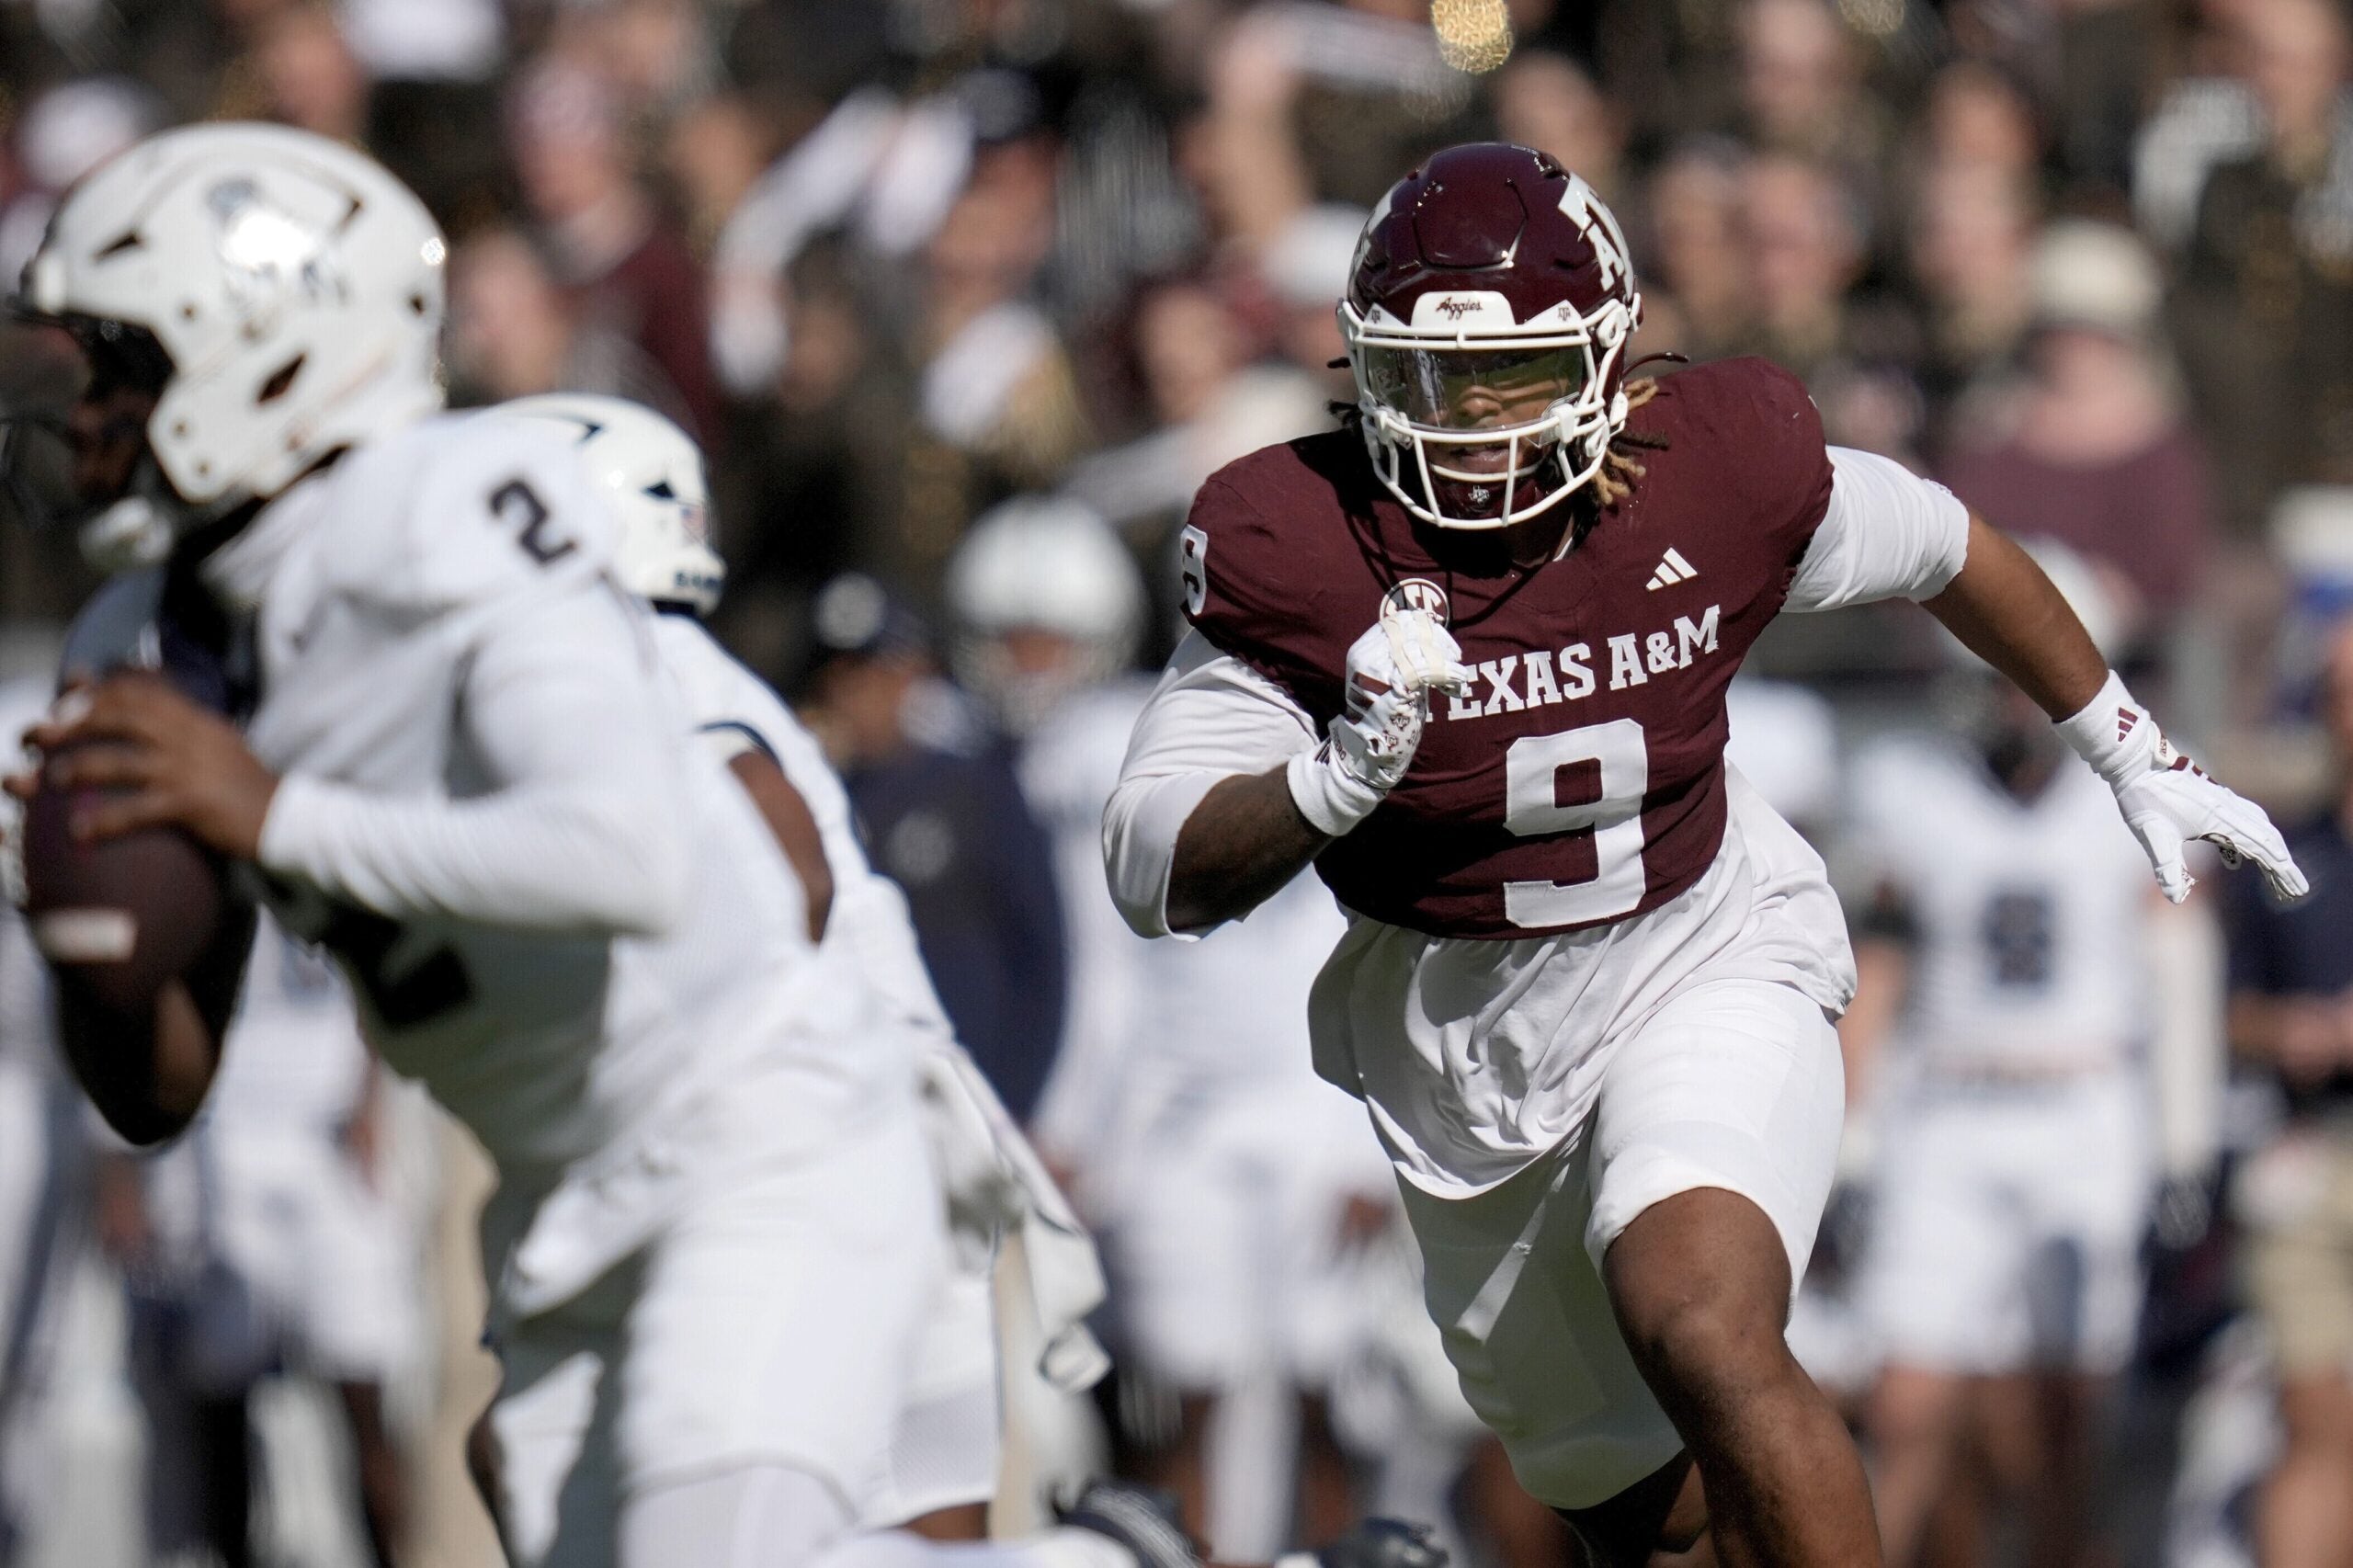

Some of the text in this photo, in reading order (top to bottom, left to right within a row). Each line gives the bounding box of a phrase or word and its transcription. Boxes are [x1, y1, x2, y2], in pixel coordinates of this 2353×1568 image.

[1435, 296, 1483, 321] Aggies
[488, 478, 577, 565] 2
[1425, 604, 1721, 722] EXAS A&M
[1503, 718, 1648, 928] 9
